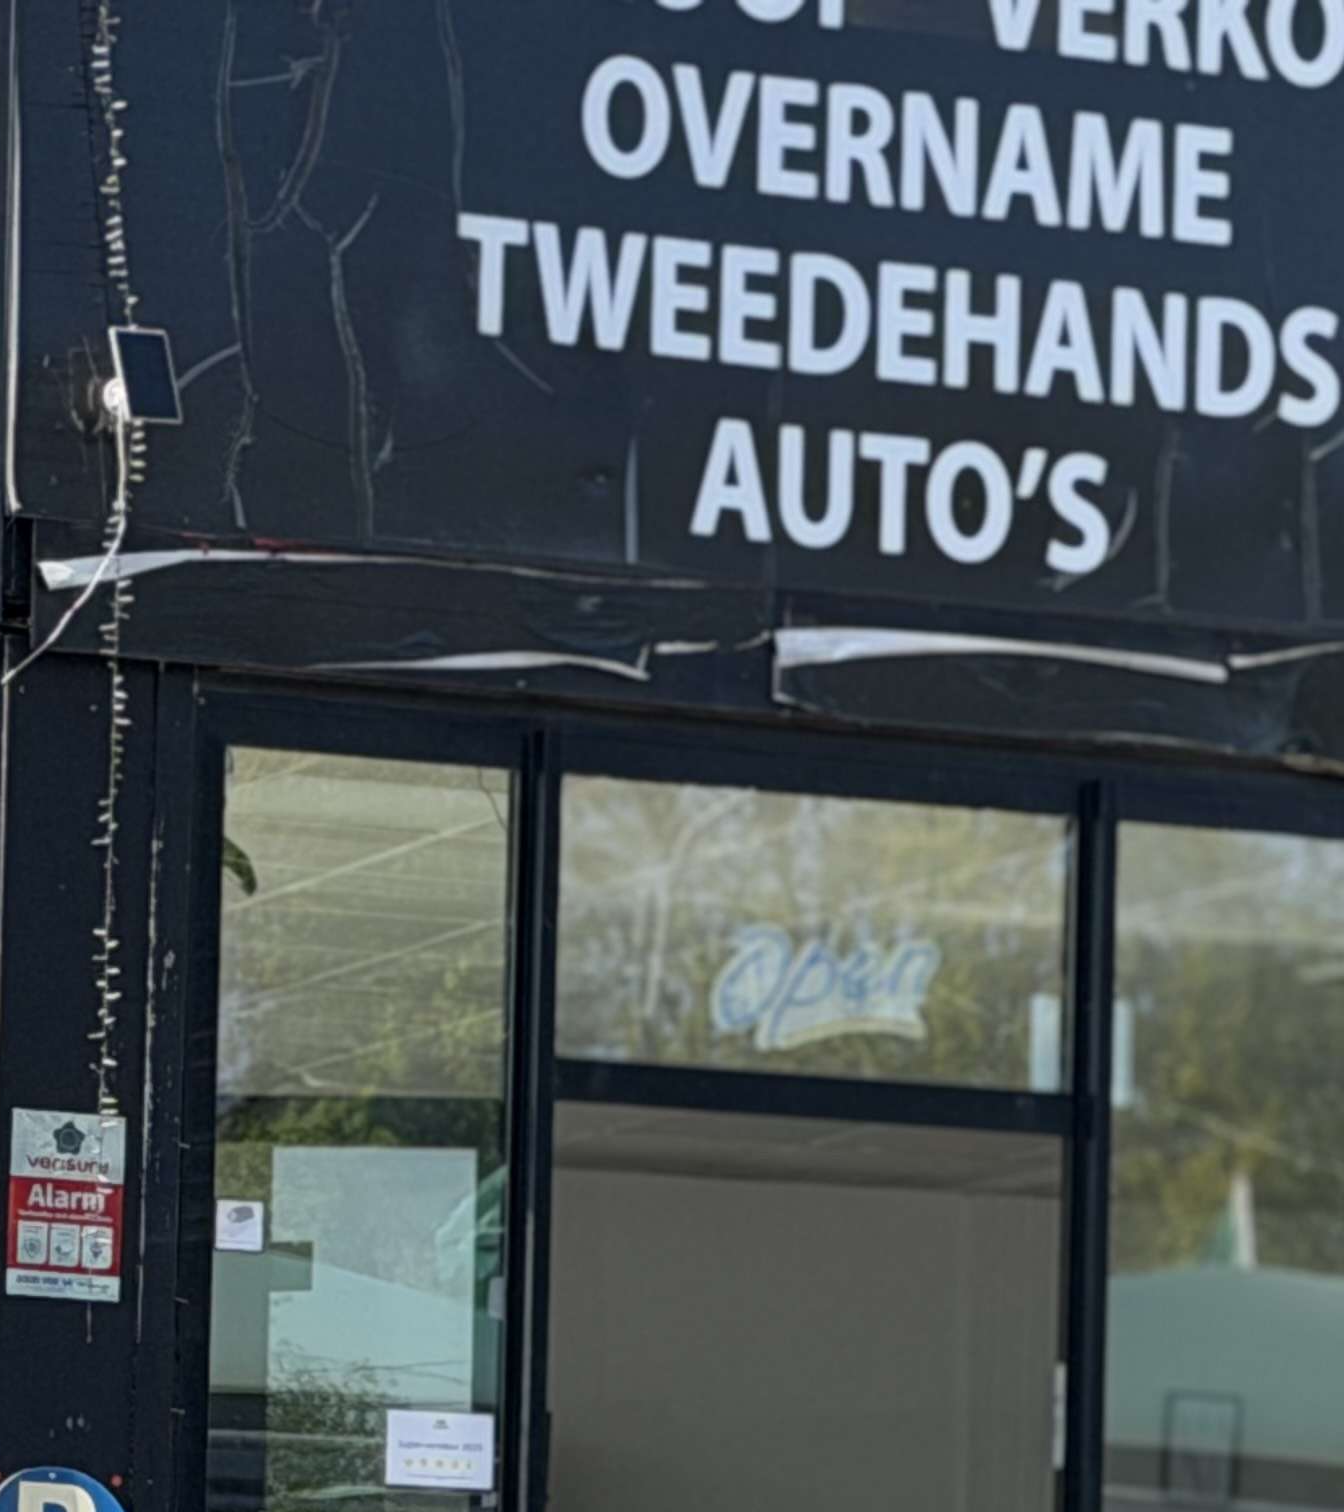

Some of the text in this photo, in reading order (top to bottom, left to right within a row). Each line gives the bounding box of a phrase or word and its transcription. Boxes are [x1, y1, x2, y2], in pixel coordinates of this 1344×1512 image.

[581, 54, 1235, 247] OVERNAME
[456, 212, 1342, 428] TWEEDEHANDS
[689, 416, 1111, 574] AUTO'S
[712, 922, 943, 1050] Open
[27, 1182, 106, 1213] Alarm
